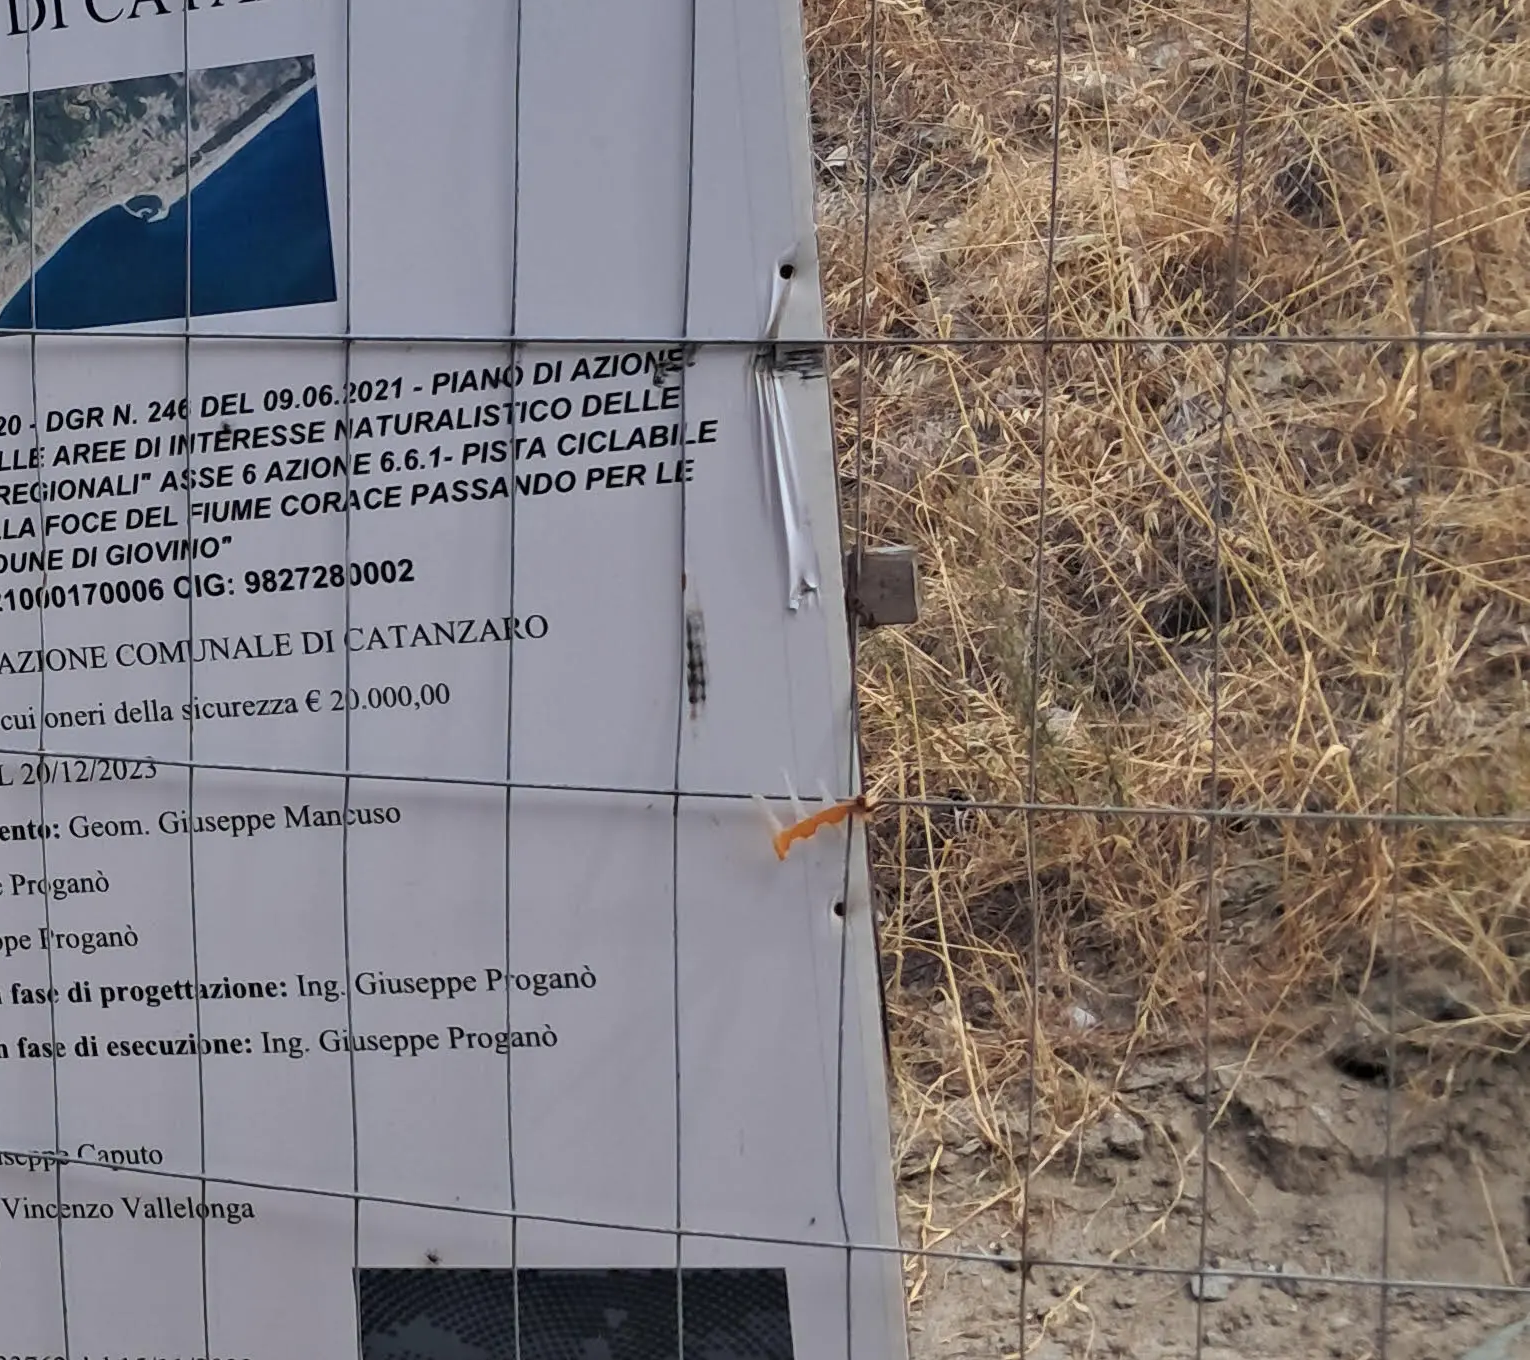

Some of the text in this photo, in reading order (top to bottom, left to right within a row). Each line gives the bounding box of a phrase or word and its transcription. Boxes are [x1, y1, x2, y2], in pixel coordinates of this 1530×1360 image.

[46, 407, 104, 432] DGR
[113, 404, 138, 427] N.
[148, 398, 191, 424] 246
[200, 392, 255, 418] DEL
[263, 376, 403, 410] 09.06.2021
[431, 364, 523, 396] PIANO
[533, 360, 562, 385] DI
[570, 348, 684, 382] AZIONE
[52, 440, 126, 466] AREE
[135, 437, 160, 460] DI
[169, 421, 326, 457] INTERESSE
[335, 396, 572, 441] NATURALISTICO
[581, 386, 681, 417] DELLE
[160, 465, 233, 493] ASSE
[242, 462, 256, 485] 6
[264, 452, 372, 484] AZIONE
[380, 445, 453, 472] 6.6.1-
[462, 436, 547, 465] PISTA
[557, 420, 718, 457] CICLABILE
[45, 511, 117, 537] FOCE
[125, 506, 178, 530] DEL
[188, 497, 272, 524] FIUME
[281, 486, 402, 516] CORACE
[411, 470, 577, 506] PASSANDO
[586, 464, 646, 492] PER
[655, 460, 695, 485] LE
[71, 545, 97, 570] DI
[106, 535, 233, 566] GIOVINO"
[173, 573, 236, 601] CIG:
[244, 558, 415, 595] 9827280002
[116, 633, 293, 667] COMUNALE
[302, 630, 336, 655] DI
[343, 614, 549, 652] CATANZARO
[0, 707, 37, 730] cui
[45, 705, 105, 729] oneri
[114, 699, 173, 724] della
[182, 696, 298, 721] sicurezza
[305, 690, 321, 713] €
[331, 683, 450, 711] 20.000,00
[22, 755, 157, 785] 20/12/2023
[69, 814, 150, 838] Geom.
[158, 810, 276, 837] Giuseppe
[284, 803, 401, 828] Mancuso
[10, 870, 110, 900] Proganò
[38, 924, 139, 955] Proganò
[11, 983, 59, 1004] fase
[67, 981, 92, 1003] di
[99, 977, 288, 1008] progettazione:
[296, 973, 346, 1002] Ing.
[354, 971, 477, 1000] Giuseppe
[484, 965, 597, 995] Proganò
[18, 1037, 66, 1058] fase
[74, 1035, 98, 1057] di
[106, 1033, 252, 1058] esecuzione:
[260, 1030, 310, 1059] Ing.
[319, 1028, 440, 1057] Giuseppe
[447, 1024, 559, 1054] Proganò
[77, 1143, 164, 1171] Caputo
[1, 1197, 114, 1220] Vincenzo
[121, 1197, 256, 1224] Vallelonga
